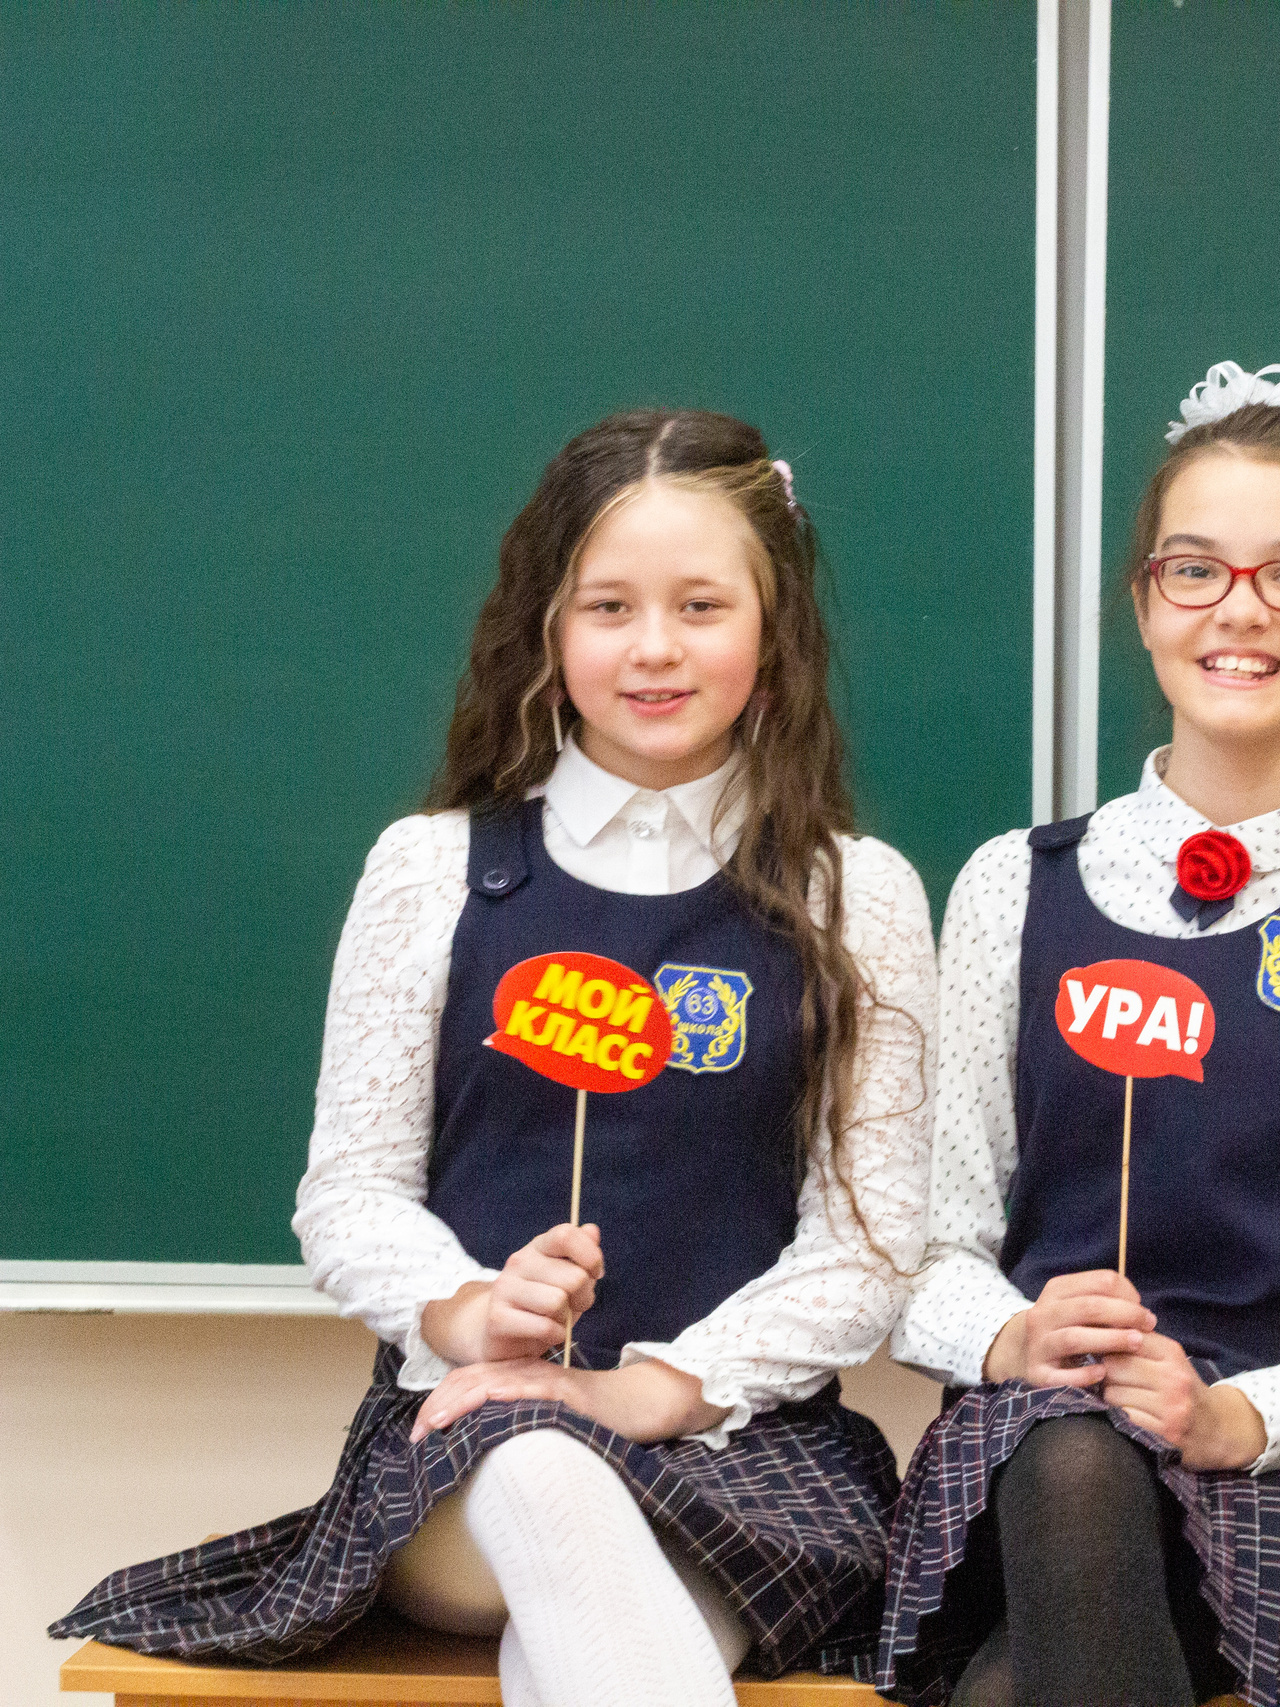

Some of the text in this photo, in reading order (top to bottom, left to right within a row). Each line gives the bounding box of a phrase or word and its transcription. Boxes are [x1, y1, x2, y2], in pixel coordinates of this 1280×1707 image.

[532, 963, 655, 1034] МОЙ
[688, 993, 715, 1016] 63
[1065, 979, 1206, 1055] УРА!
[504, 1000, 654, 1080] КЛАСС
